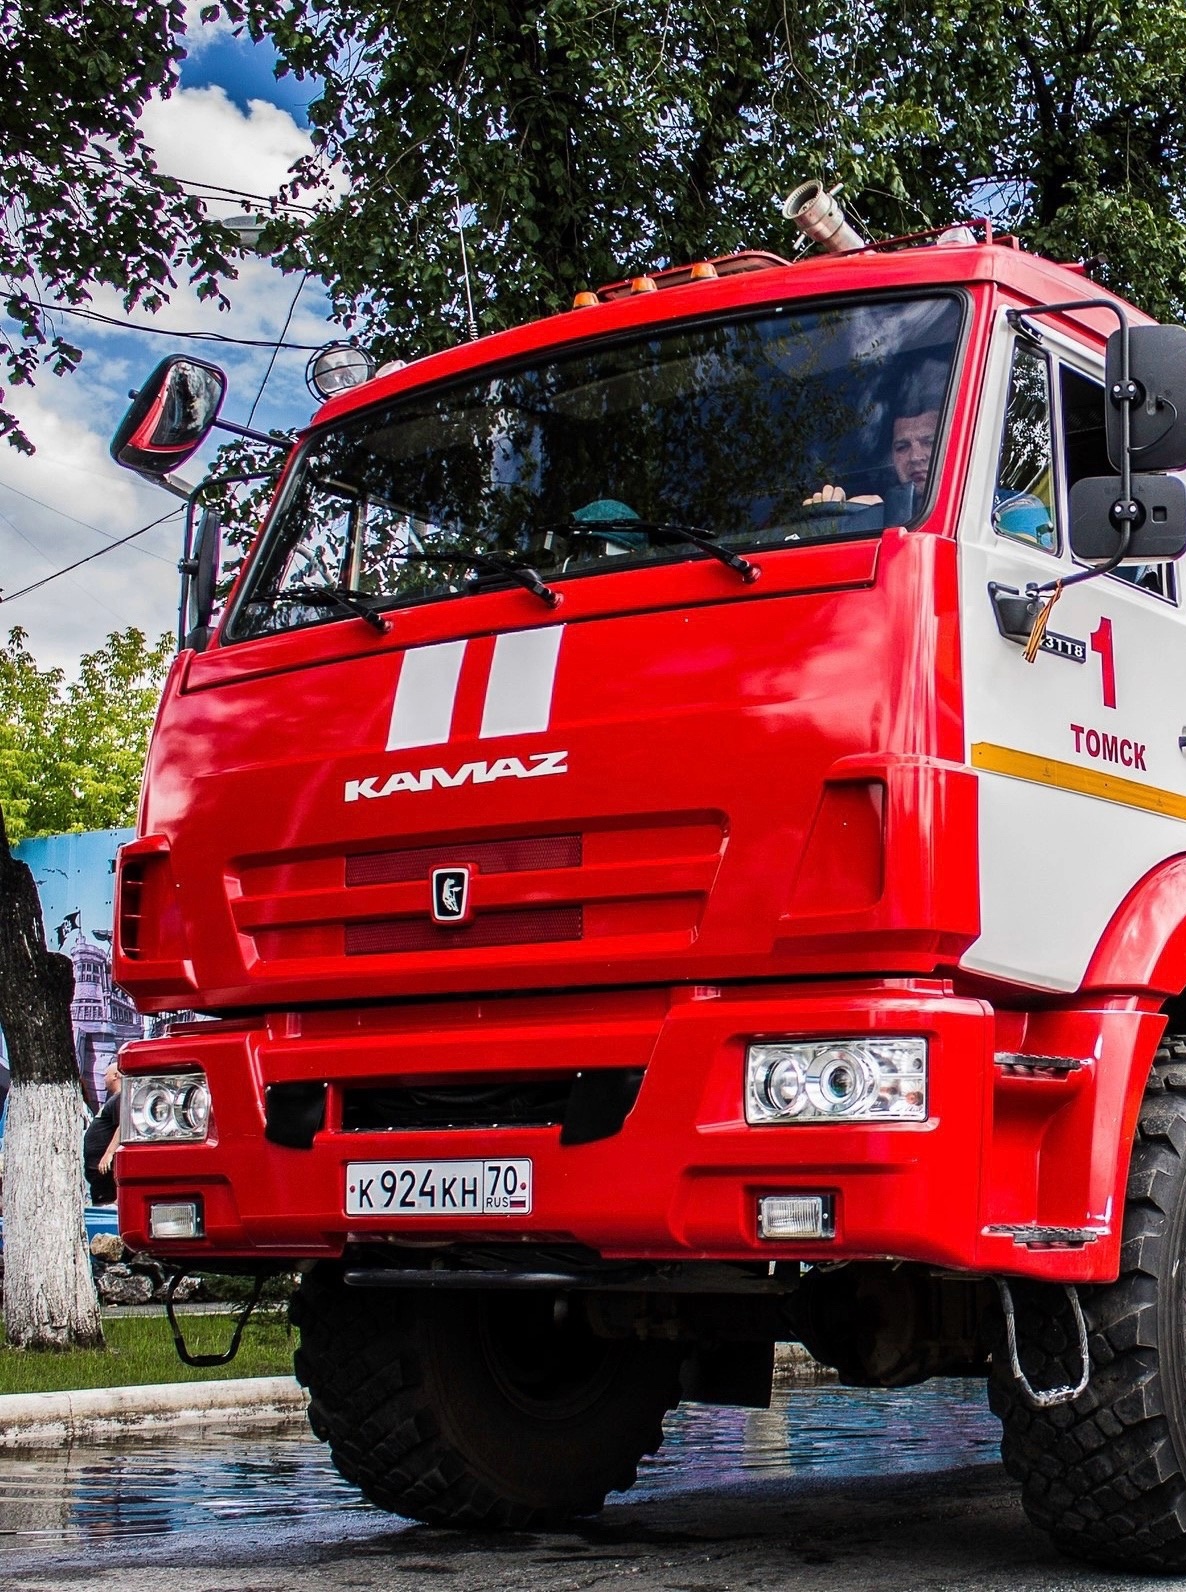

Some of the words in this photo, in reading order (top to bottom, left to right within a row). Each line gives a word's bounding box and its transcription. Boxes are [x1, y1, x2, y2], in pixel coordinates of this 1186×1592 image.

[1040, 635, 1083, 657] 3118
[1090, 616, 1117, 709] 1
[1070, 723, 1147, 771] ТОМСК
[344, 750, 569, 802] KAMAZ
[488, 1166, 518, 1196] 70
[486, 1197, 508, 1208] RUS
